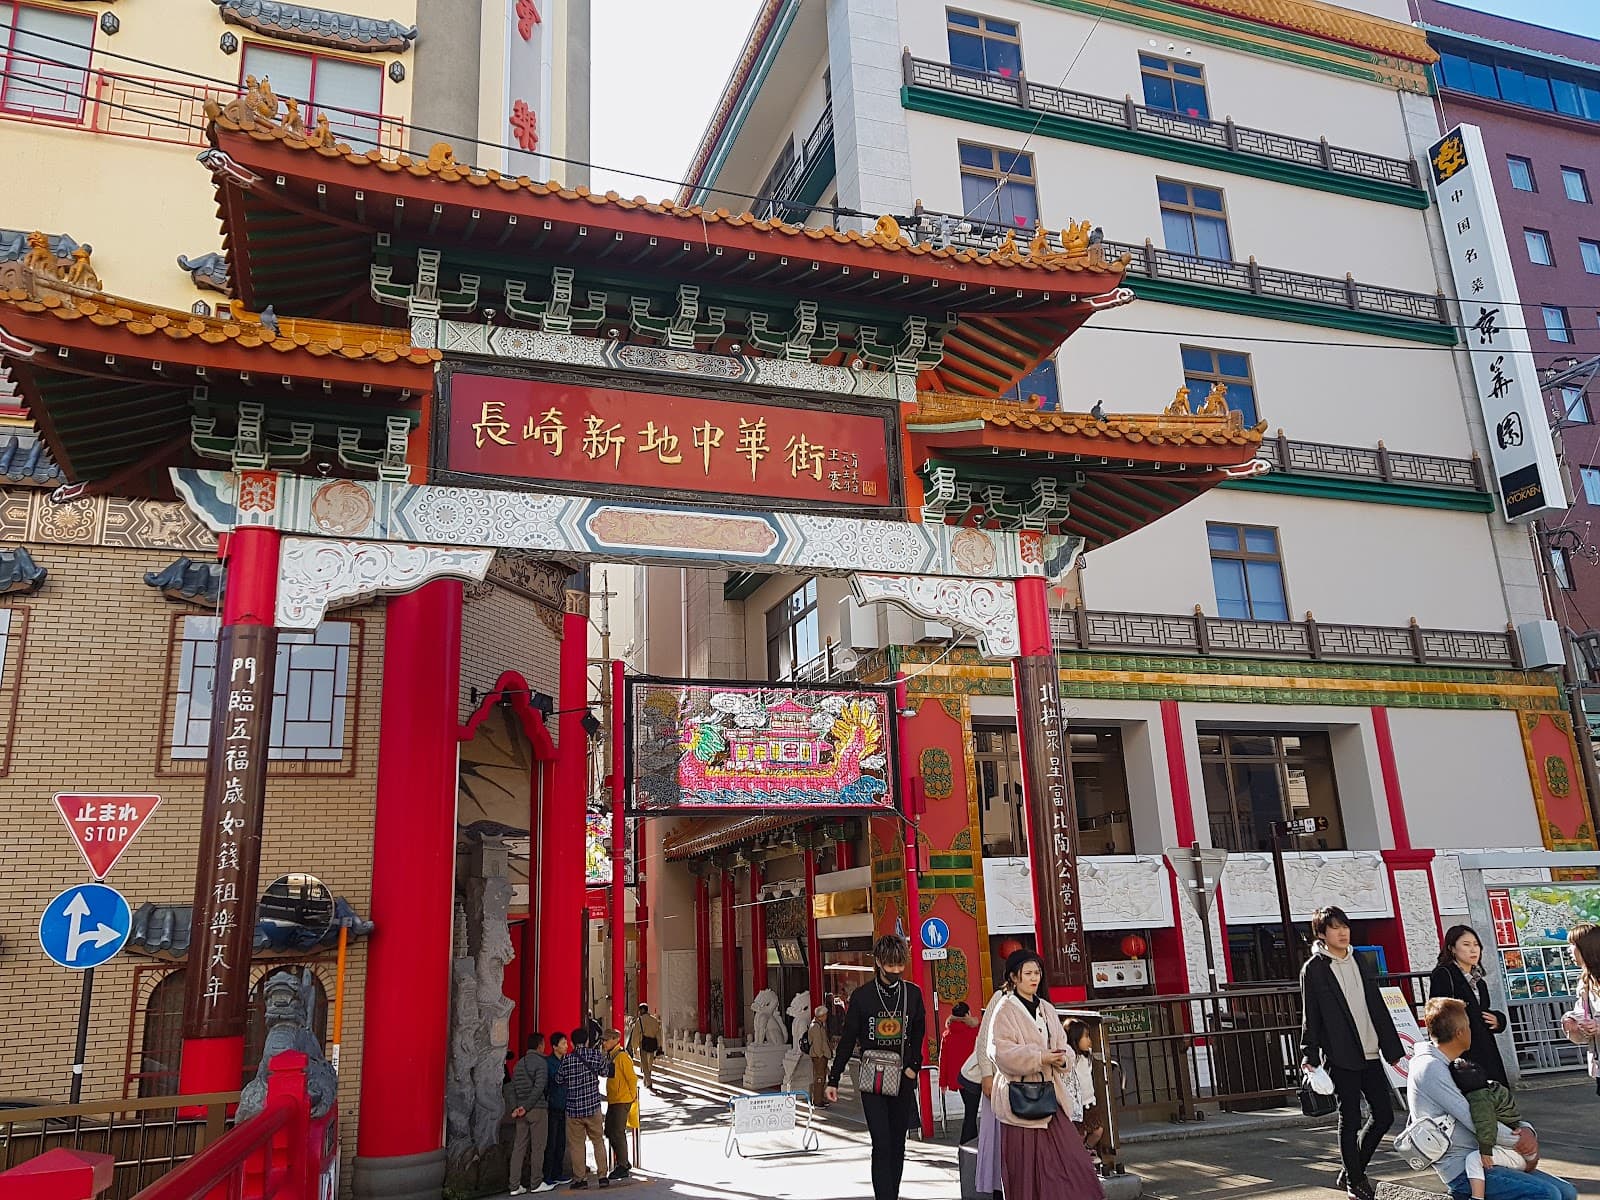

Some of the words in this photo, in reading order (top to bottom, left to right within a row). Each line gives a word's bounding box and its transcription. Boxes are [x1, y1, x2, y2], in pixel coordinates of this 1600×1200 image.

[1451, 189, 1484, 295] 中国名菜
[471, 401, 825, 482] 長崎新地中華街
[827, 448, 843, 491] 王震
[75, 802, 139, 822] 止まれ
[84, 826, 128, 842] STOP
[868, 1016, 876, 1040] GUCCI
